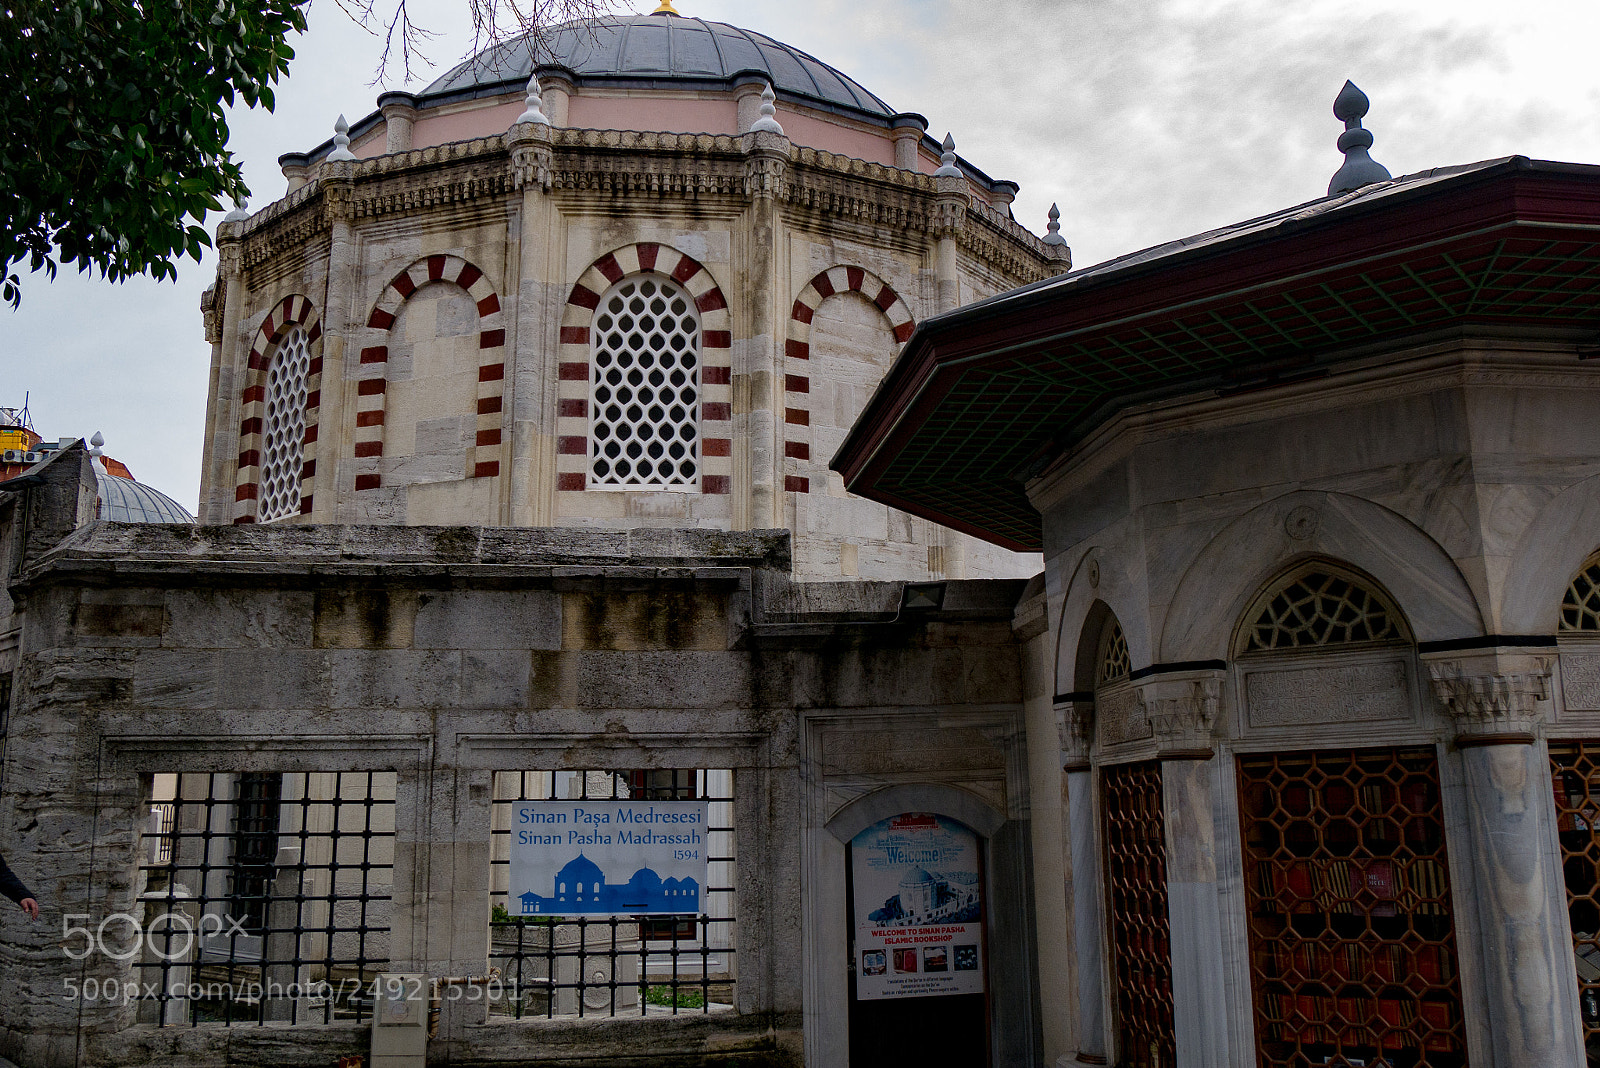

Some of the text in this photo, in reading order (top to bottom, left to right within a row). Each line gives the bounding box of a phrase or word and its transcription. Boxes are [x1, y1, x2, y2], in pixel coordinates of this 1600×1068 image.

[519, 807, 701, 828] Sinan Paşa Medresesi
[518, 828, 701, 845] Sinan Pasha Madrassah
[673, 850, 700, 860] 1594
[871, 929, 906, 938] WELCOME
[919, 927, 940, 935] SINAN
[941, 926, 966, 934] PASHA
[884, 935, 953, 945] ISLAMIC BOOKSHOP
